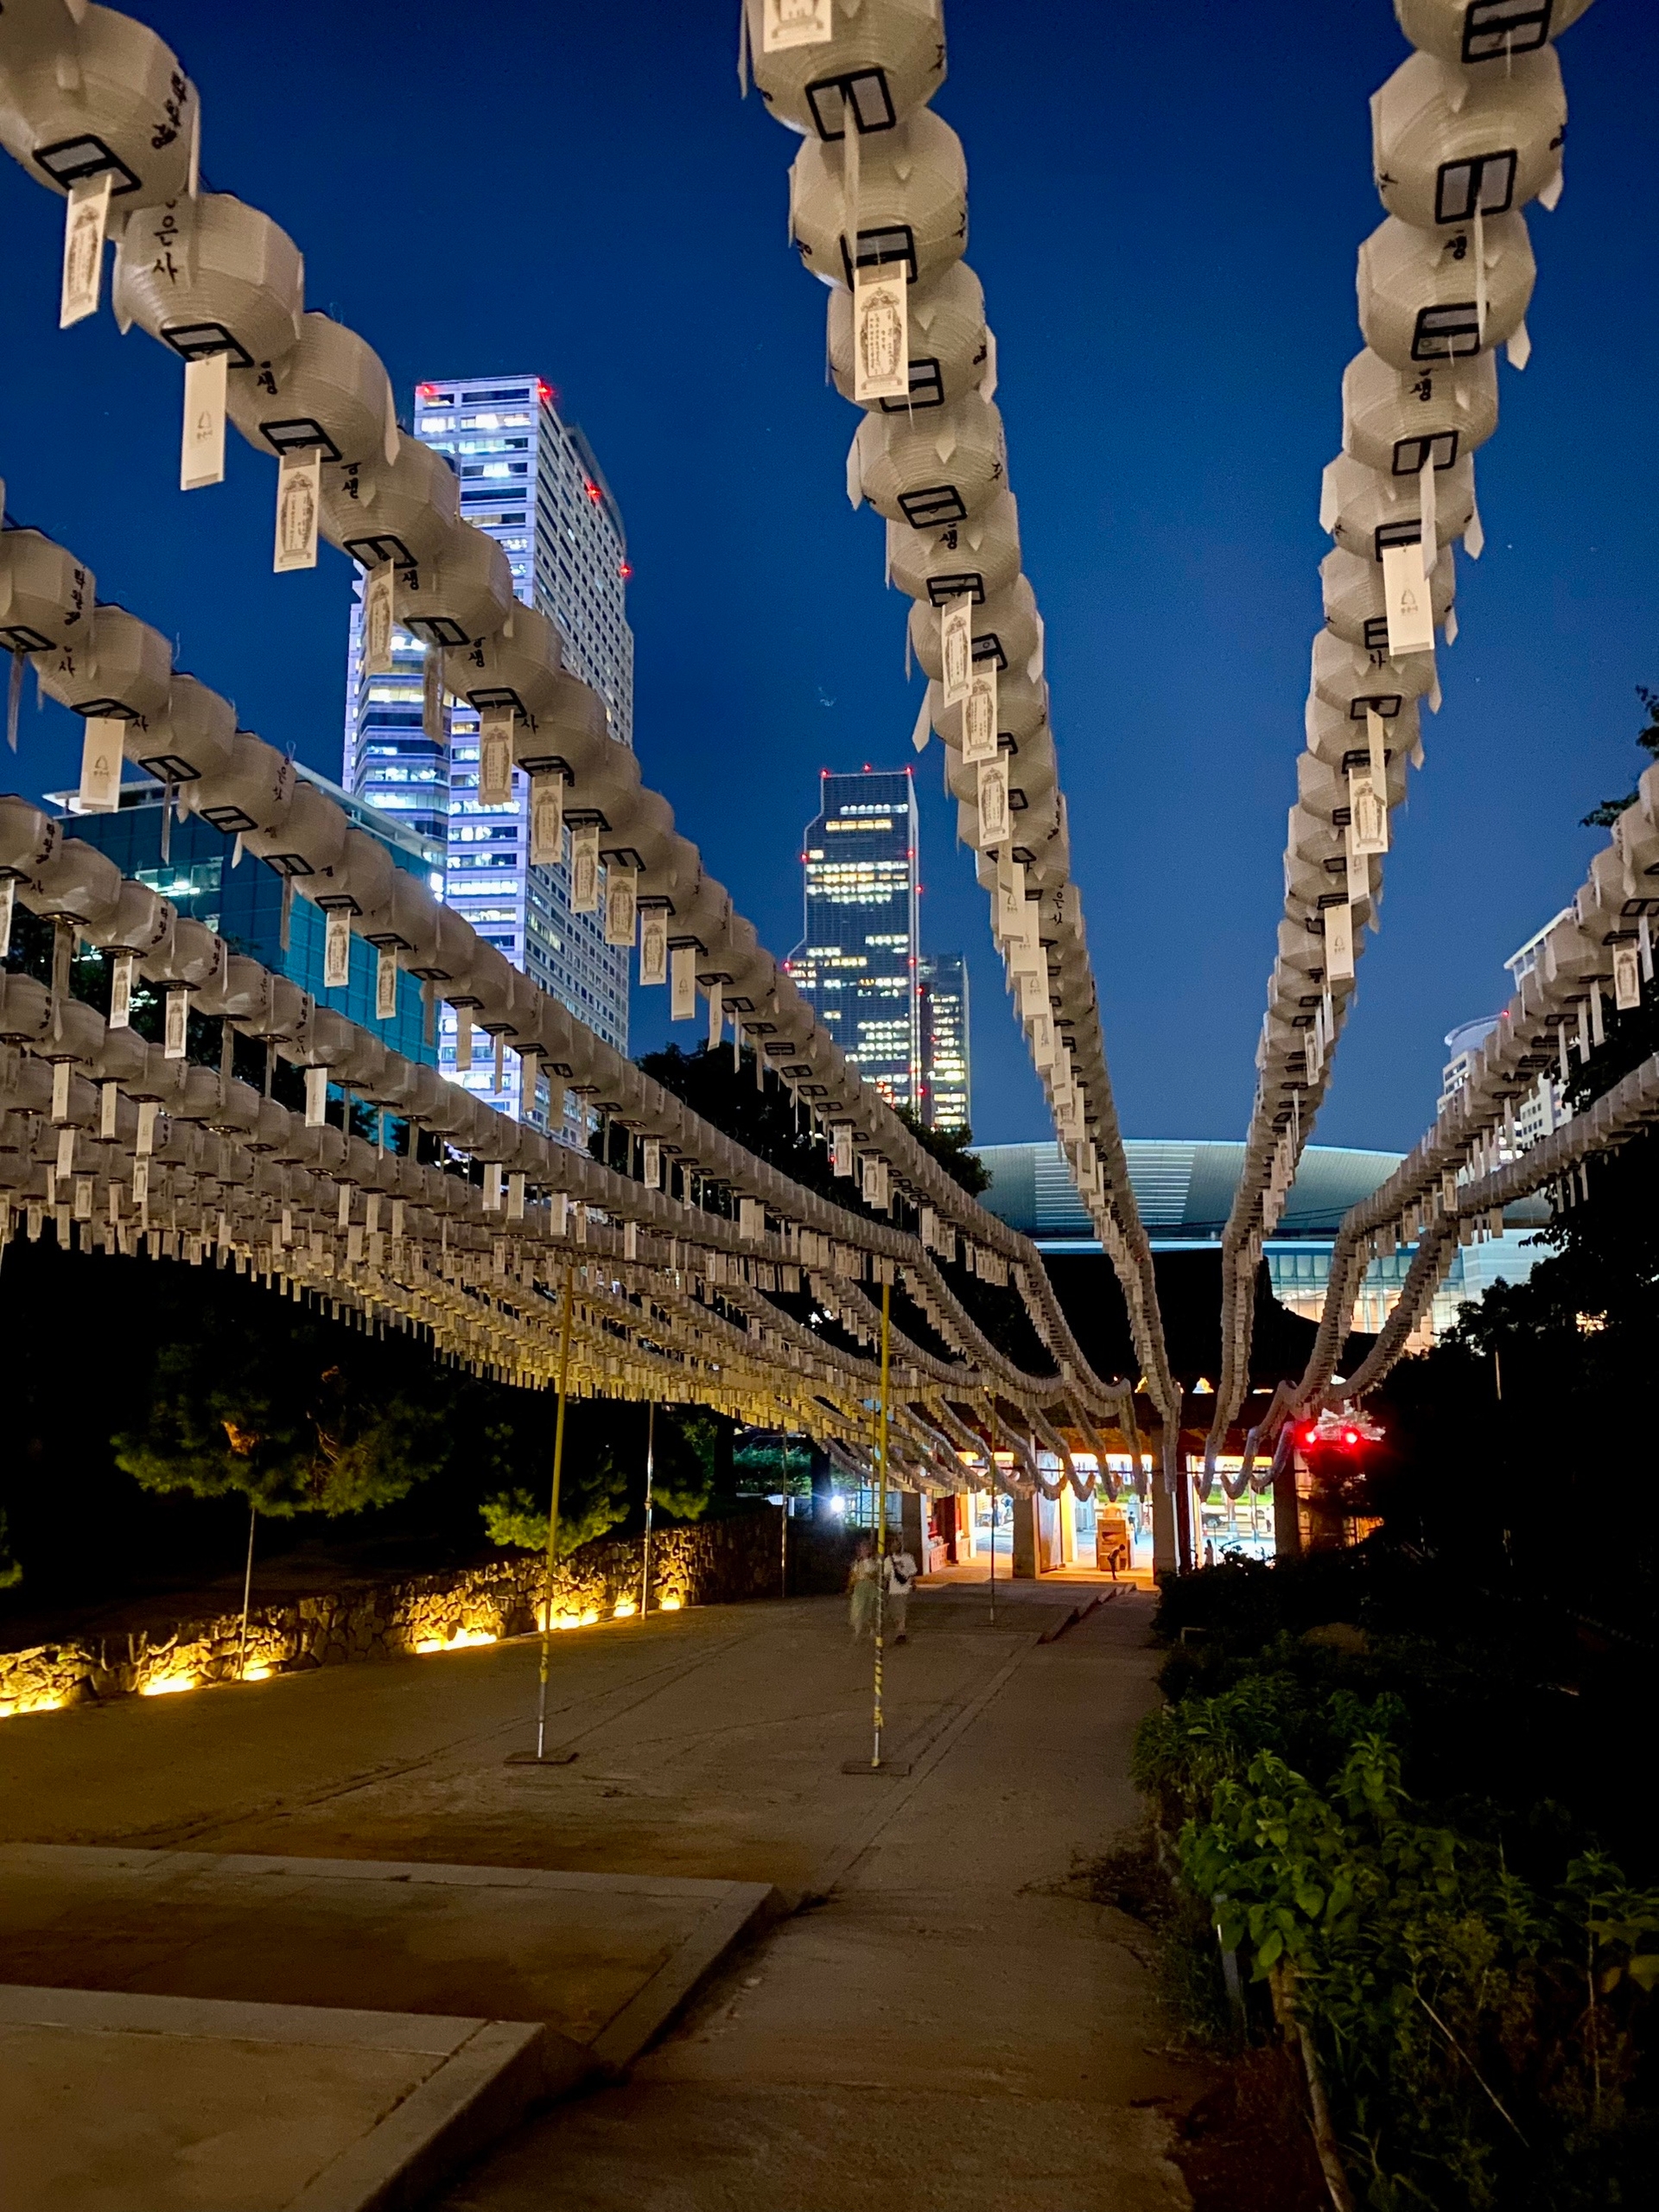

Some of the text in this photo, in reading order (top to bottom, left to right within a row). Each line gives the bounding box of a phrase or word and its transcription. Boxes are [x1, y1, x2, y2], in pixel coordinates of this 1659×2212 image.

[1444, 230, 1468, 261] 생
[257, 360, 278, 395] 생
[1409, 369, 1433, 402] 생
[938, 523, 958, 550] 생
[58, 645, 76, 678] 사
